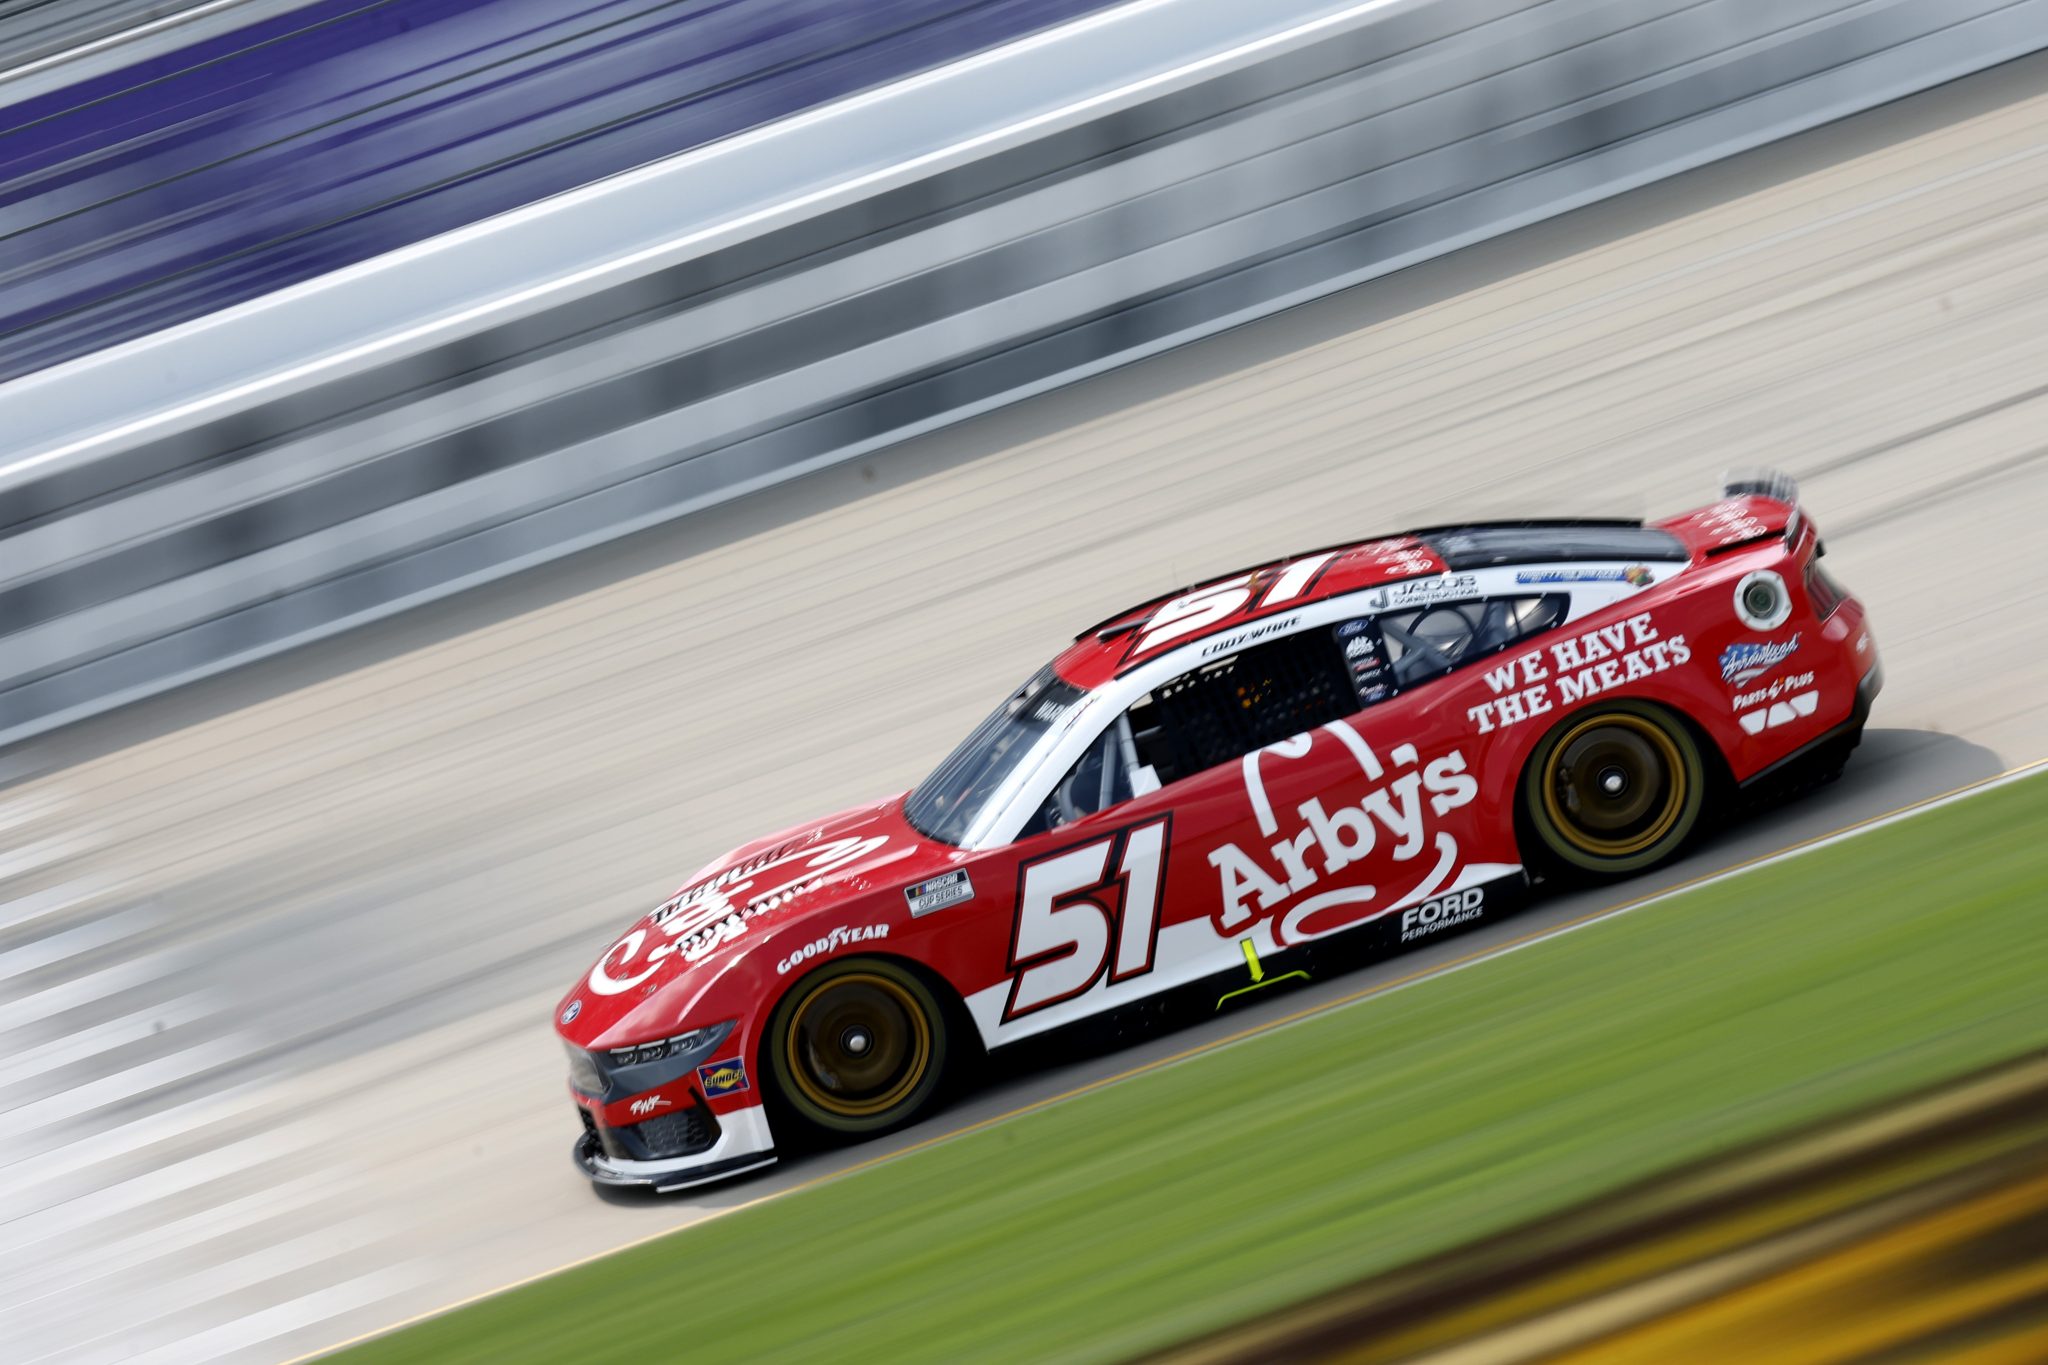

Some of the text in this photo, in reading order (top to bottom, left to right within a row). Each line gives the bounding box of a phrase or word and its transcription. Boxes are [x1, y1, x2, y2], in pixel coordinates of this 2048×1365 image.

[1122, 550, 1341, 663] 51
[1394, 575, 1477, 597] JACOB
[1483, 612, 1659, 694] WE HAVE
[1467, 634, 1692, 735] THE MEATS
[1208, 743, 1478, 929] Arby's
[918, 885, 963, 909] CUP SERIES
[926, 873, 959, 894] NASCAR
[1003, 812, 1172, 1022] 51
[1401, 905, 1484, 943] PERFORMANCE
[1402, 887, 1484, 932] FORD
[777, 924, 889, 975] GOODYEAR
[704, 1068, 744, 1088] SUNOCO
